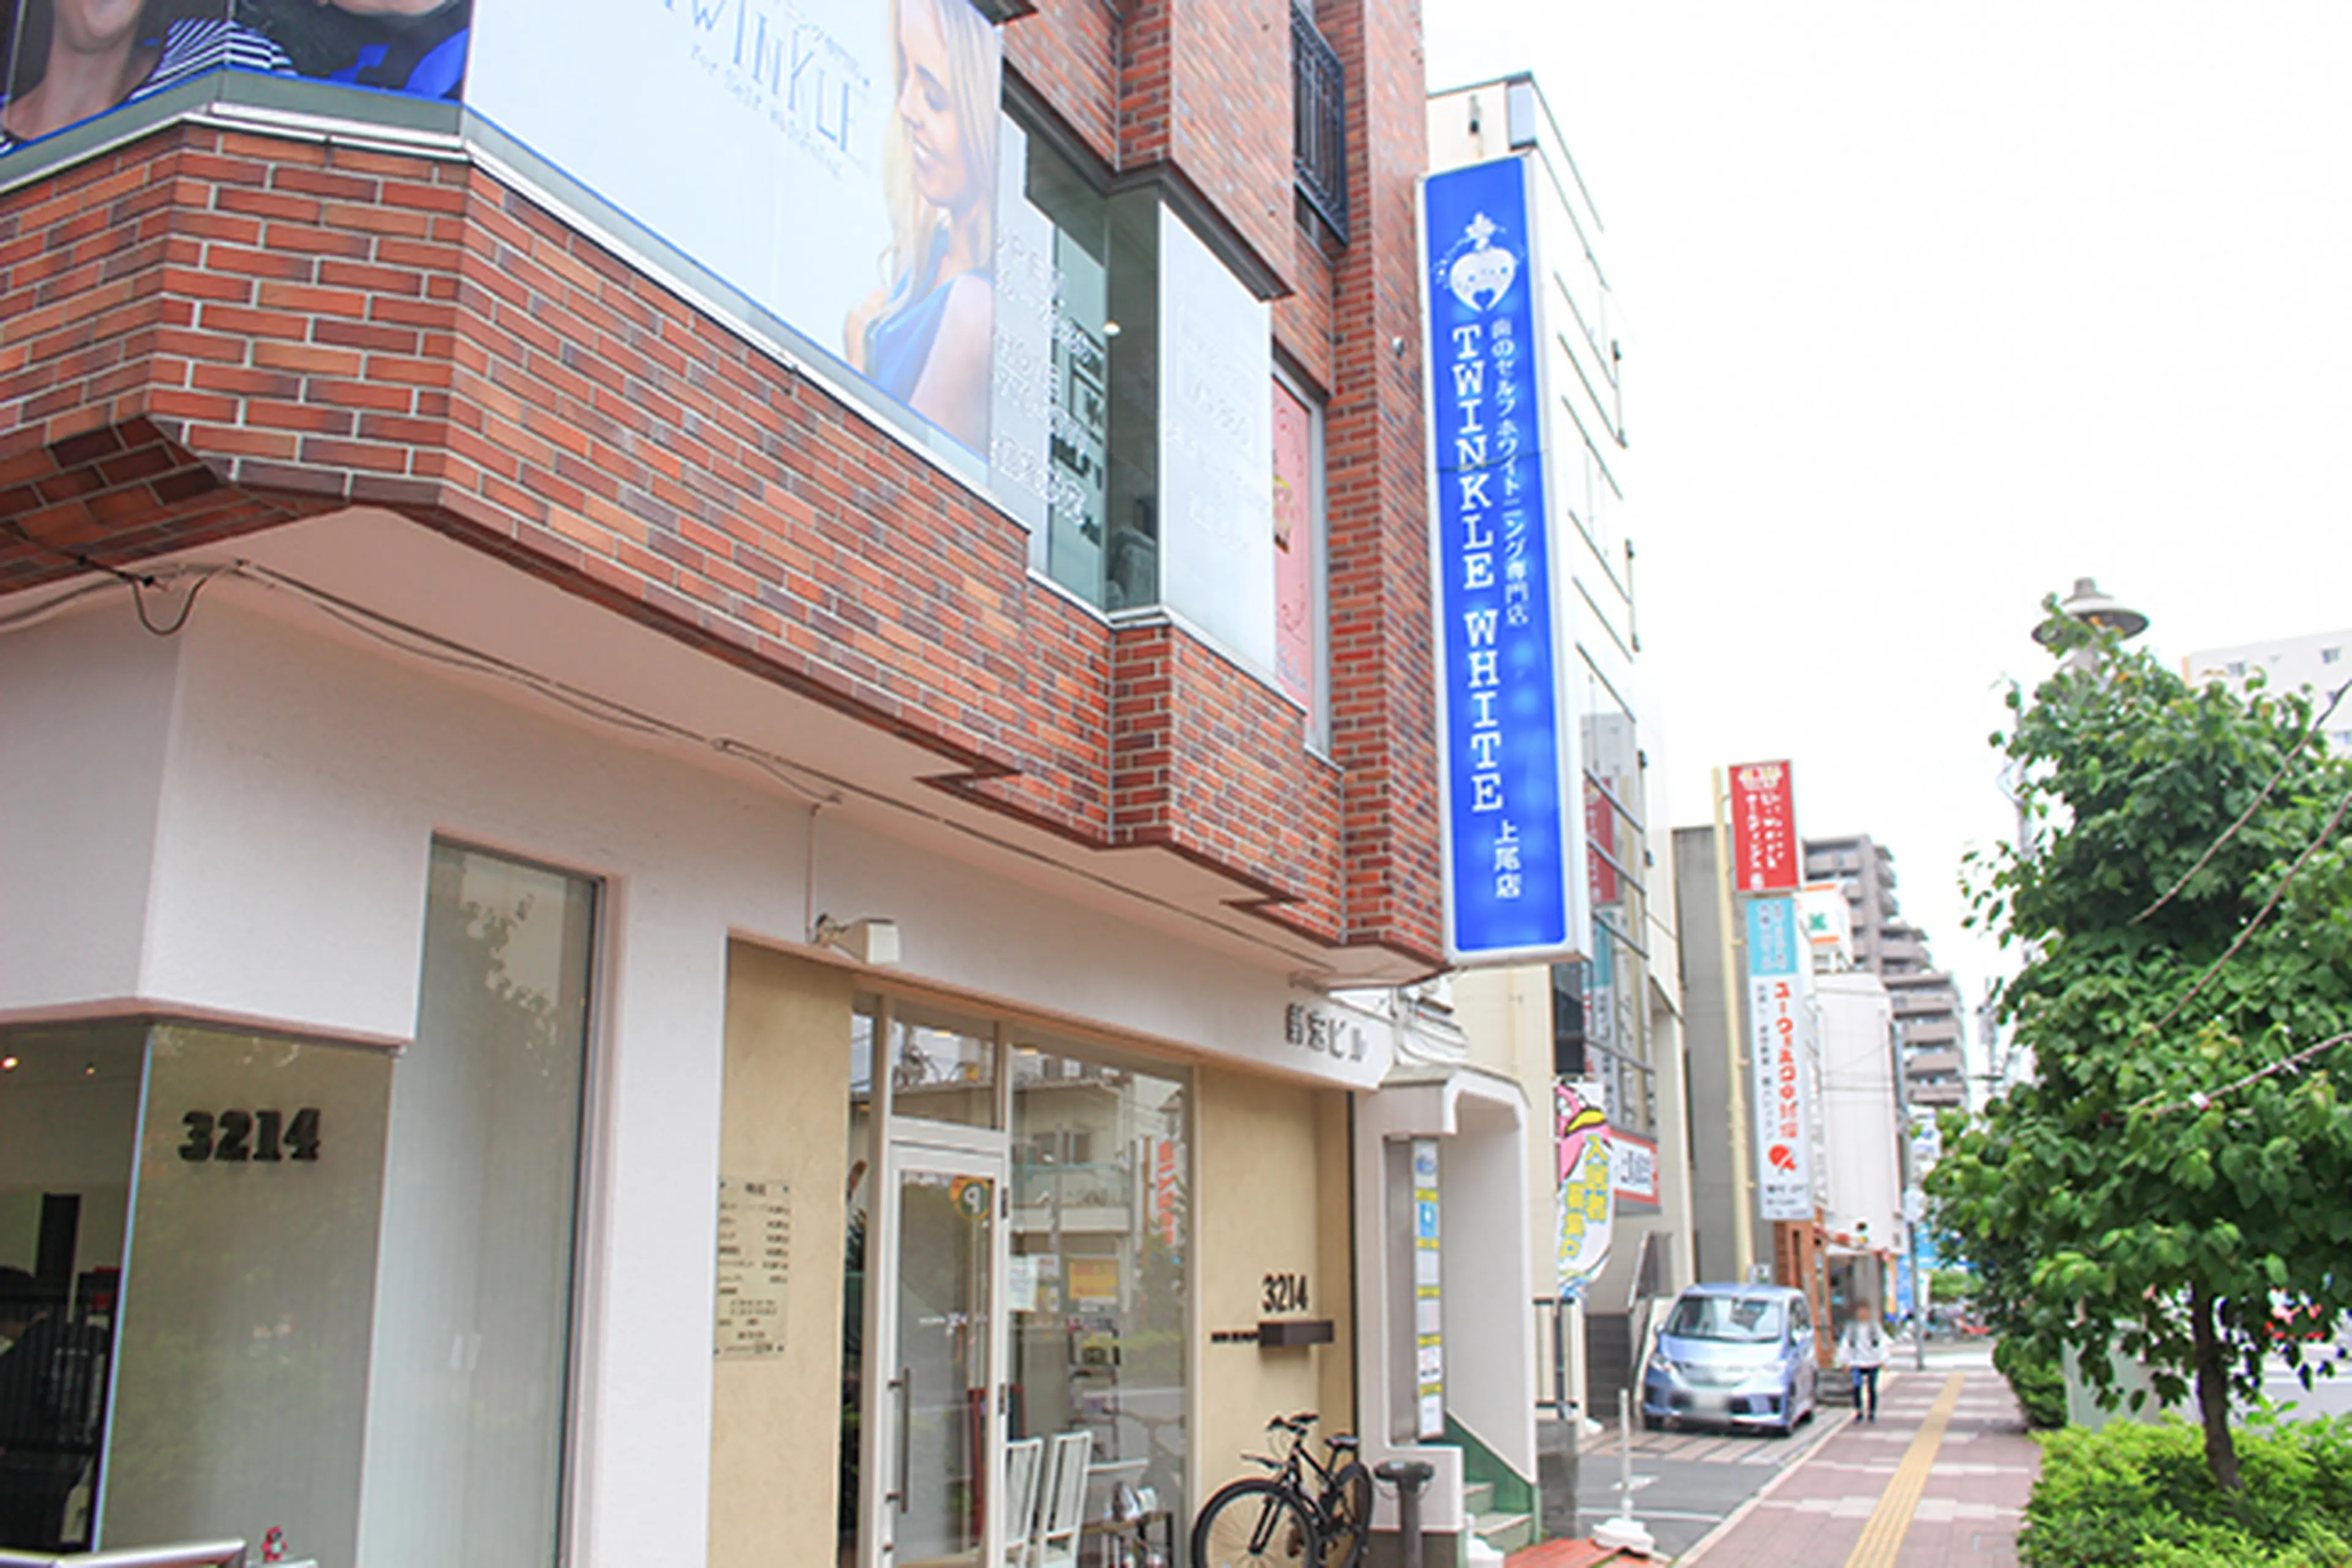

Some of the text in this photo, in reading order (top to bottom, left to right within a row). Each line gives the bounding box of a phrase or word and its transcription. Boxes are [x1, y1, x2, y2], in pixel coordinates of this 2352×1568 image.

[1452, 324, 1503, 812] TWINKLE WHITE
[1494, 820, 1521, 899] 上尾店
[178, 1108, 321, 1162] 3214
[1262, 1273, 1309, 1313] 3214
